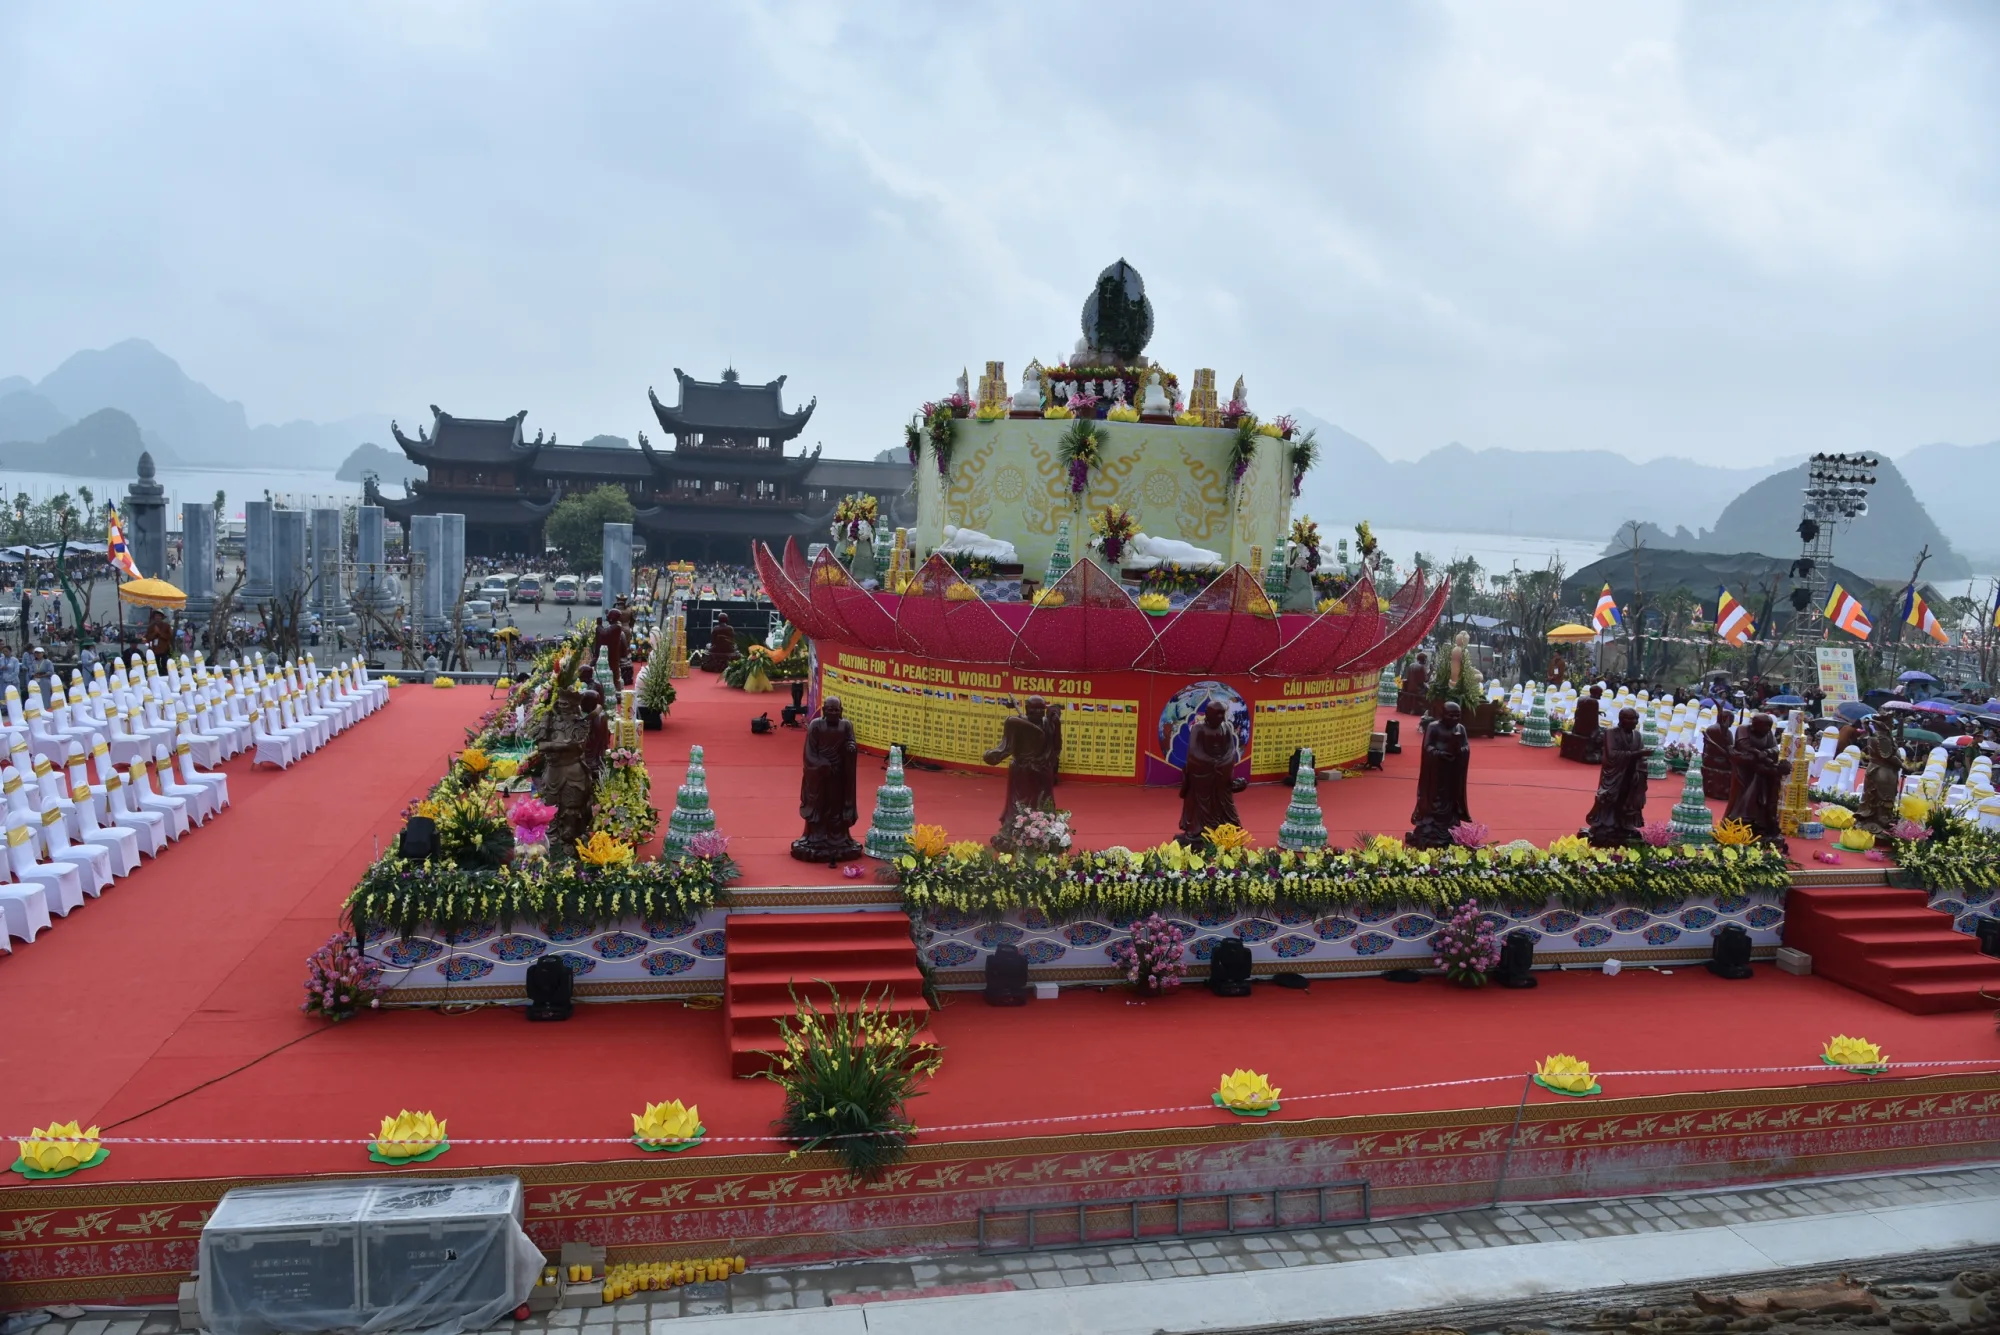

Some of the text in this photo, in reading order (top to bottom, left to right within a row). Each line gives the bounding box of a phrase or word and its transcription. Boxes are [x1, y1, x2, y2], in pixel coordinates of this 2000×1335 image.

[838, 652, 868, 671] PRAYING
[870, 659, 886, 674] FOR
[903, 664, 955, 684] PEACEFUL
[1013, 676, 1055, 693] VESAK
[1058, 680, 1092, 695] 2019
